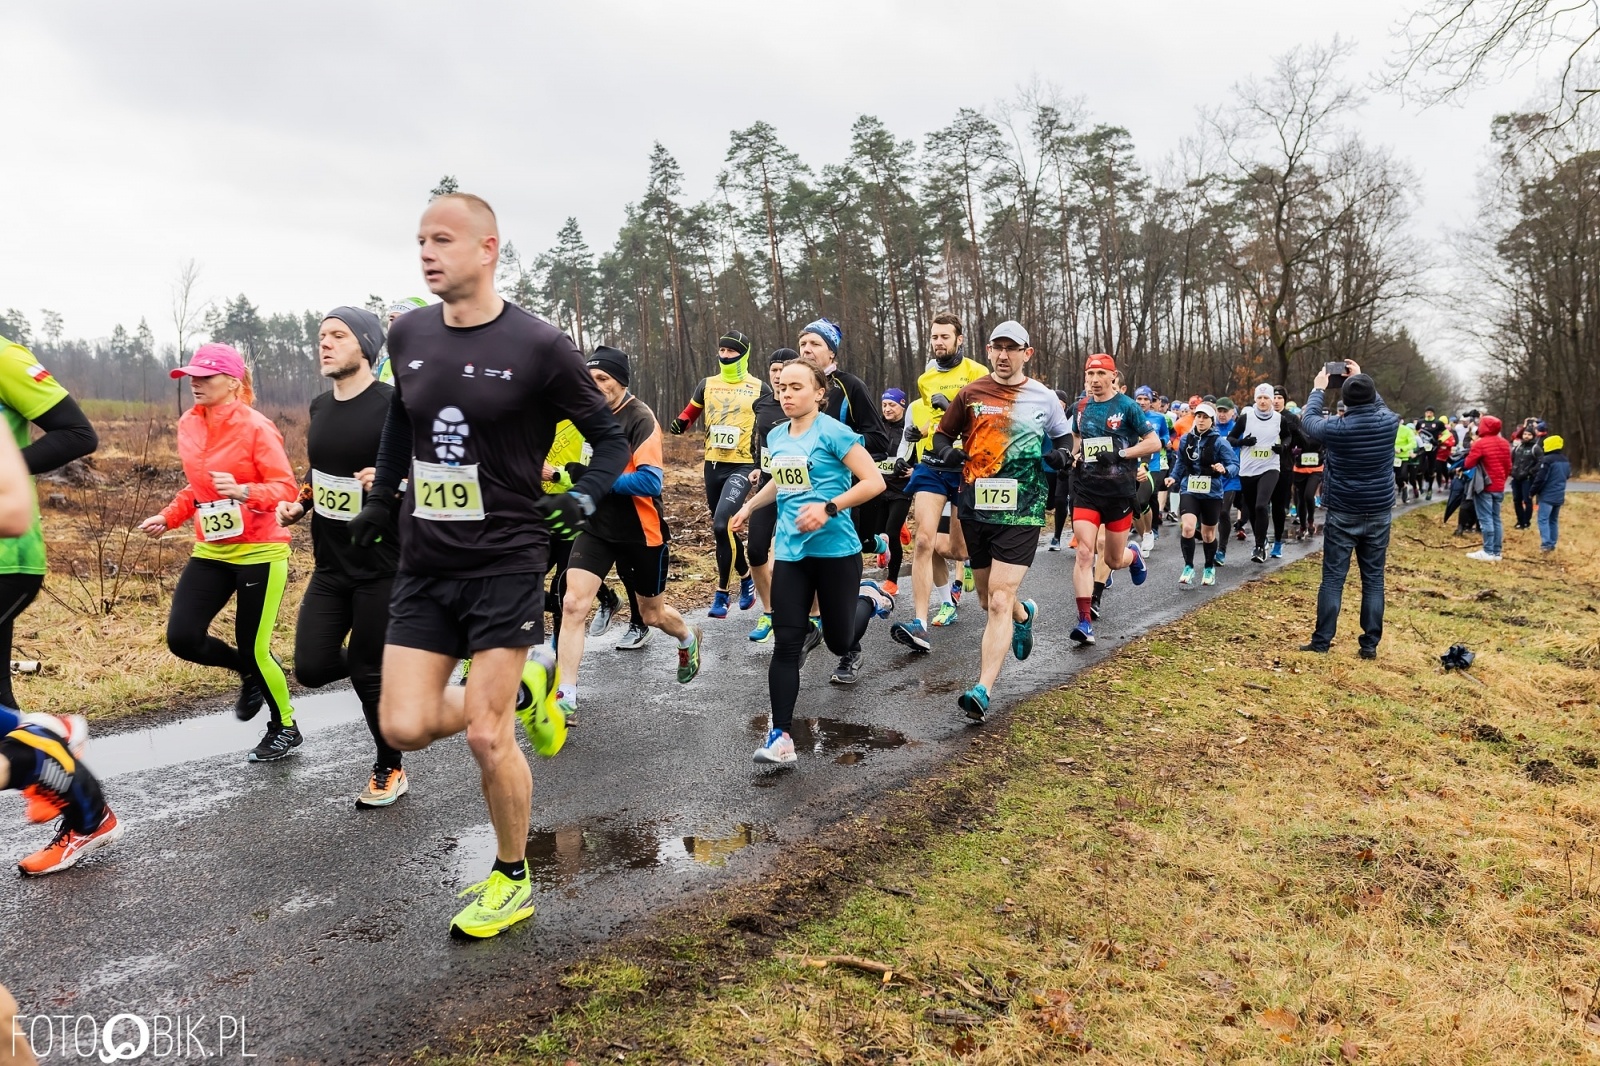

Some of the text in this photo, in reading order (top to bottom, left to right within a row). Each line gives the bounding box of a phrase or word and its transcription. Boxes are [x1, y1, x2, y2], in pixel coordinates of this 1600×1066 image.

[714, 433, 734, 444] 176
[878, 461, 894, 471] 264
[777, 468, 803, 484] 168
[1191, 481, 1207, 489] 173
[318, 487, 351, 512] 262
[423, 482, 468, 508] 219
[982, 489, 1010, 503] 175
[203, 512, 234, 533] 233
